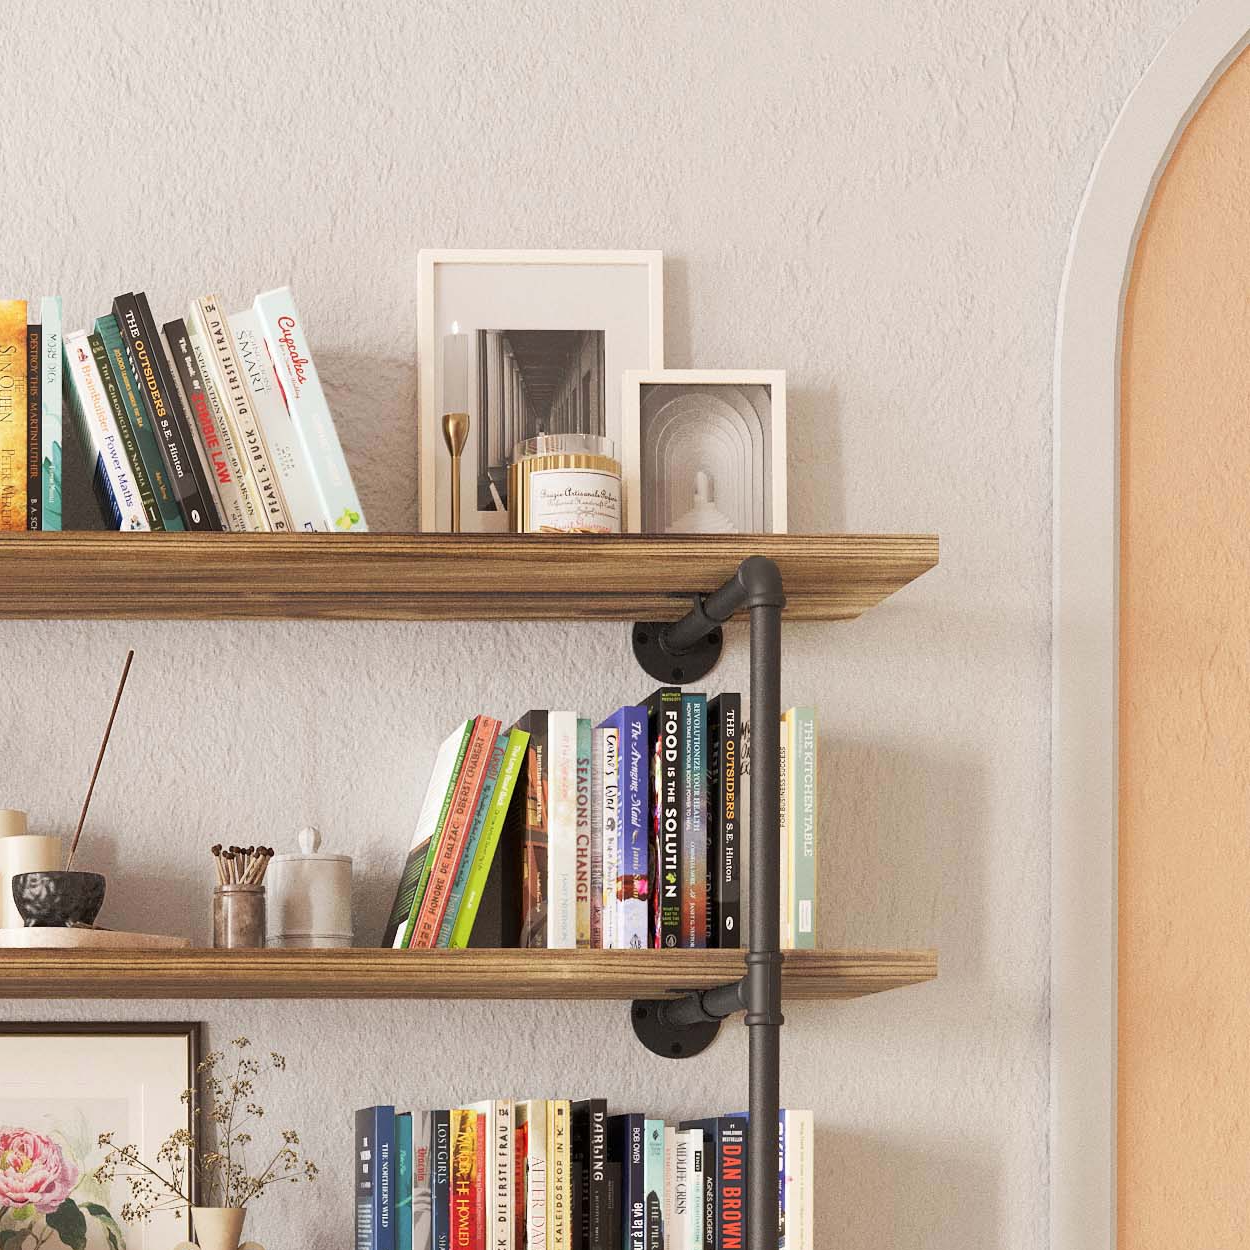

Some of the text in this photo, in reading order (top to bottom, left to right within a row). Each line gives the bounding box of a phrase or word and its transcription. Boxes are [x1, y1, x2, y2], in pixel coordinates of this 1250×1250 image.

[30, 333, 38, 396] DESTROY THIS
[211, 321, 247, 414] DIE ERSTE FRAU
[278, 317, 308, 384] Cupcakes
[125, 310, 184, 478] THE OUTSIDERS S.E. Hinton
[195, 346, 248, 499] EXPLORATION NORTH YEARS
[30, 403, 38, 478] MARTIN LUTHER
[191, 392, 231, 484] ZOMBIE LAW
[246, 430, 279, 513] PEARL BUCK
[666, 712, 677, 762] FOOD
[726, 710, 734, 736] THE
[630, 721, 641, 827] The Avenging Maid
[726, 741, 734, 819] OUTSIDERS
[804, 720, 813, 856] THE KITCHEN TABLE
[577, 758, 589, 903] SEASONS CHANGE
[726, 824, 734, 843] S.E.
[438, 1124, 448, 1184] LOST GIRLS
[499, 1126, 507, 1222] DIE ERSTE FRAU
[591, 1112, 603, 1181] DARLING
[676, 1142, 686, 1215] MIDLIFE CRISIS
[723, 1145, 742, 1180] DAN
[532, 1157, 544, 1208] AFTER
[634, 1203, 643, 1217] vie
[723, 1187, 742, 1248] BROWN
[632, 1220, 643, 1228] la
